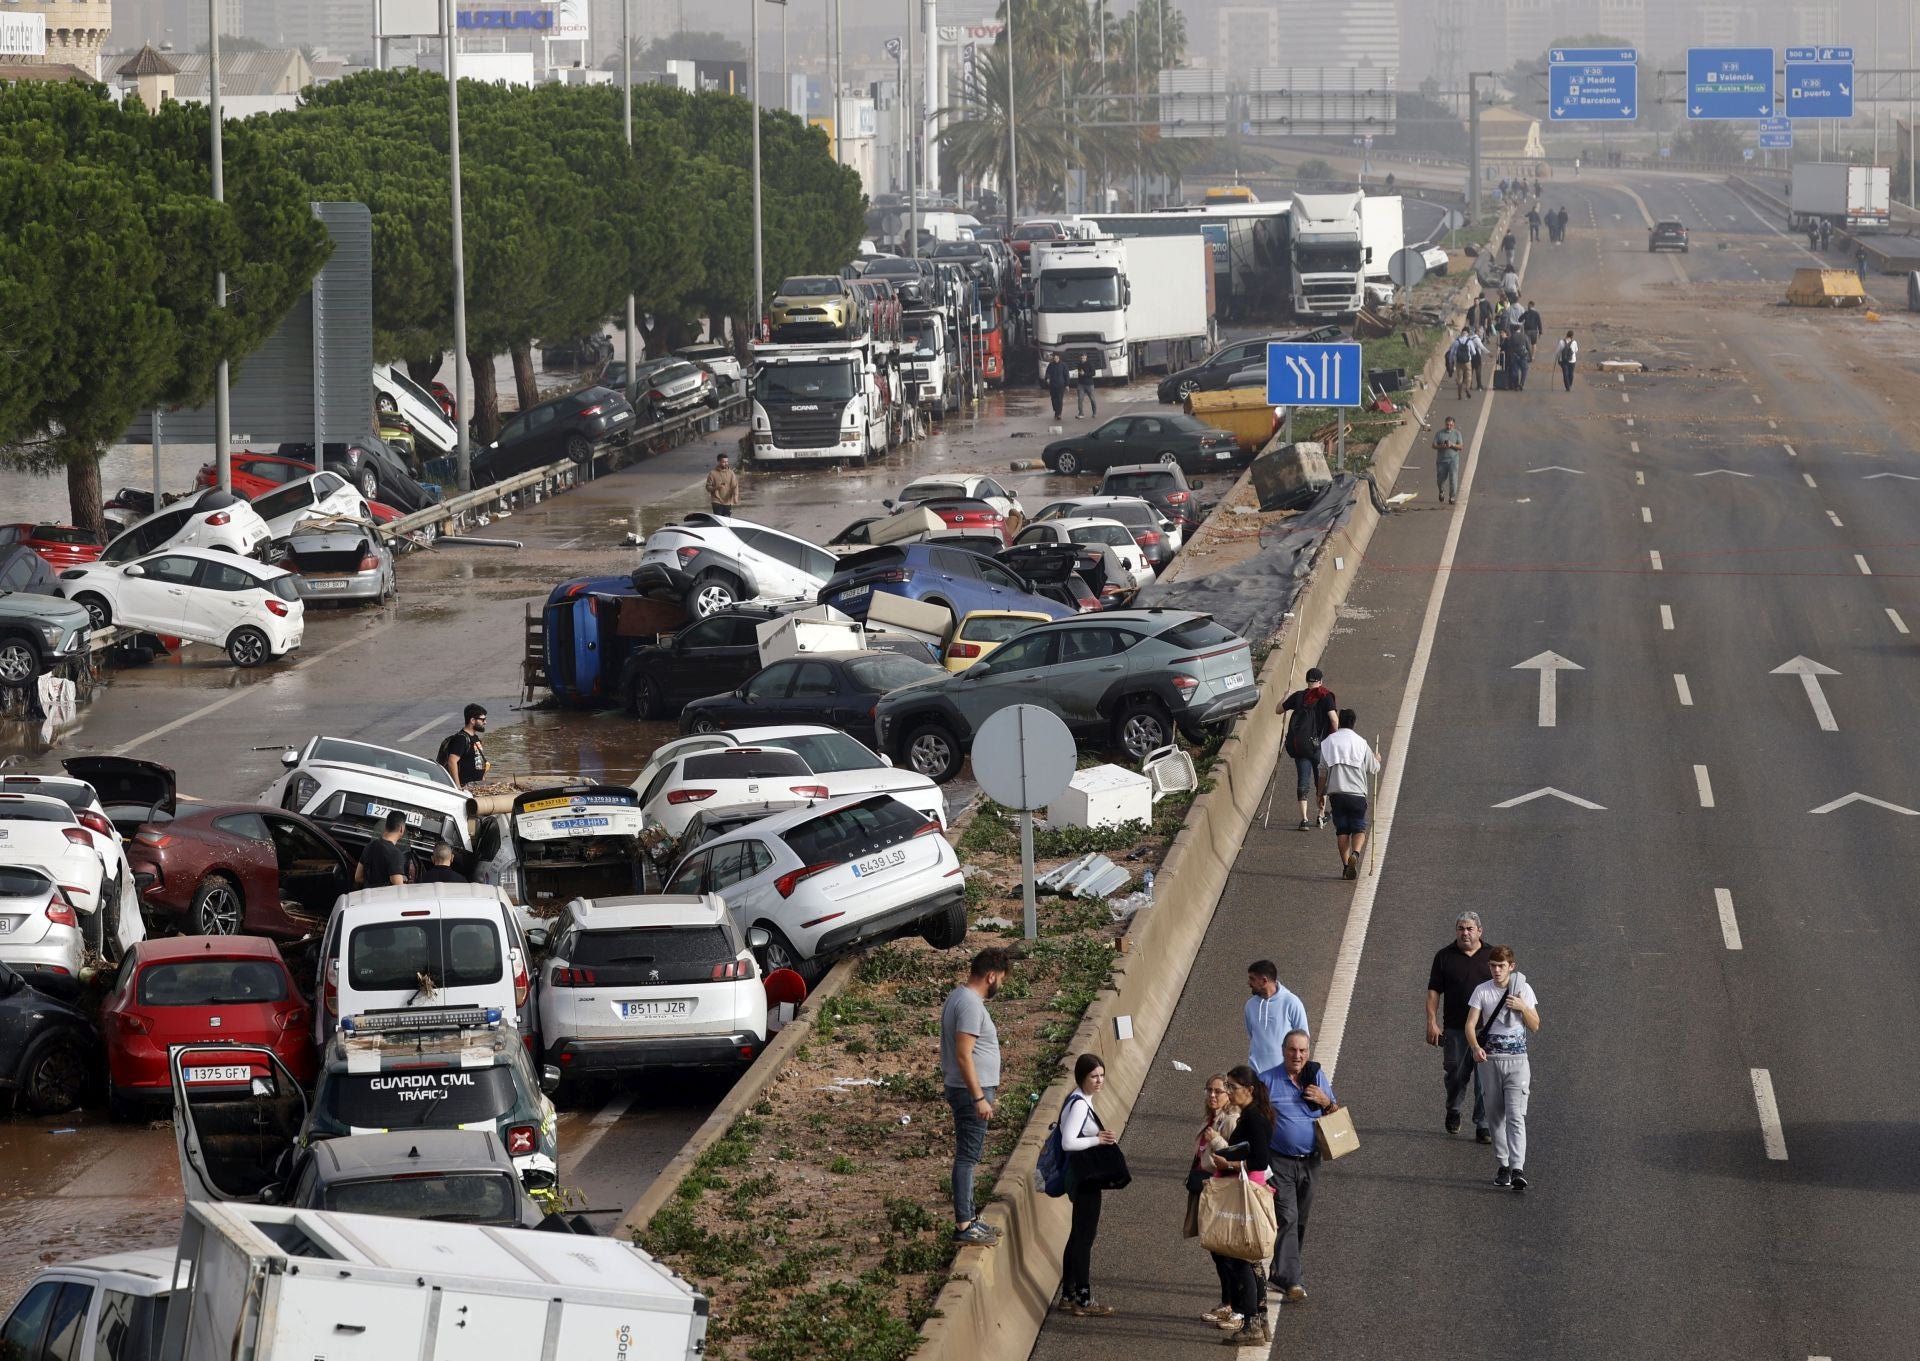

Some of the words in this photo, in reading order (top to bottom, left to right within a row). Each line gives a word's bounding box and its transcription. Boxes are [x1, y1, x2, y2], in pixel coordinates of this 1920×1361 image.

[1587, 76, 1616, 84] Madrid
[1580, 96, 1621, 104] Barcelona
[1803, 90, 1831, 98] puerto
[560, 819, 585, 829] 3128
[859, 857, 886, 873] 6439
[886, 850, 906, 864] LSD
[630, 1002, 659, 1015] 8511
[664, 1002, 686, 1013] JZR
[194, 1068, 222, 1079] 1375
[225, 1067, 248, 1079] GFY
[370, 1074, 437, 1090] GUARDIA
[440, 1073, 475, 1086] CIVIL
[397, 1088, 448, 1102] TRÁFICO
[617, 1324, 630, 1361] SODE
